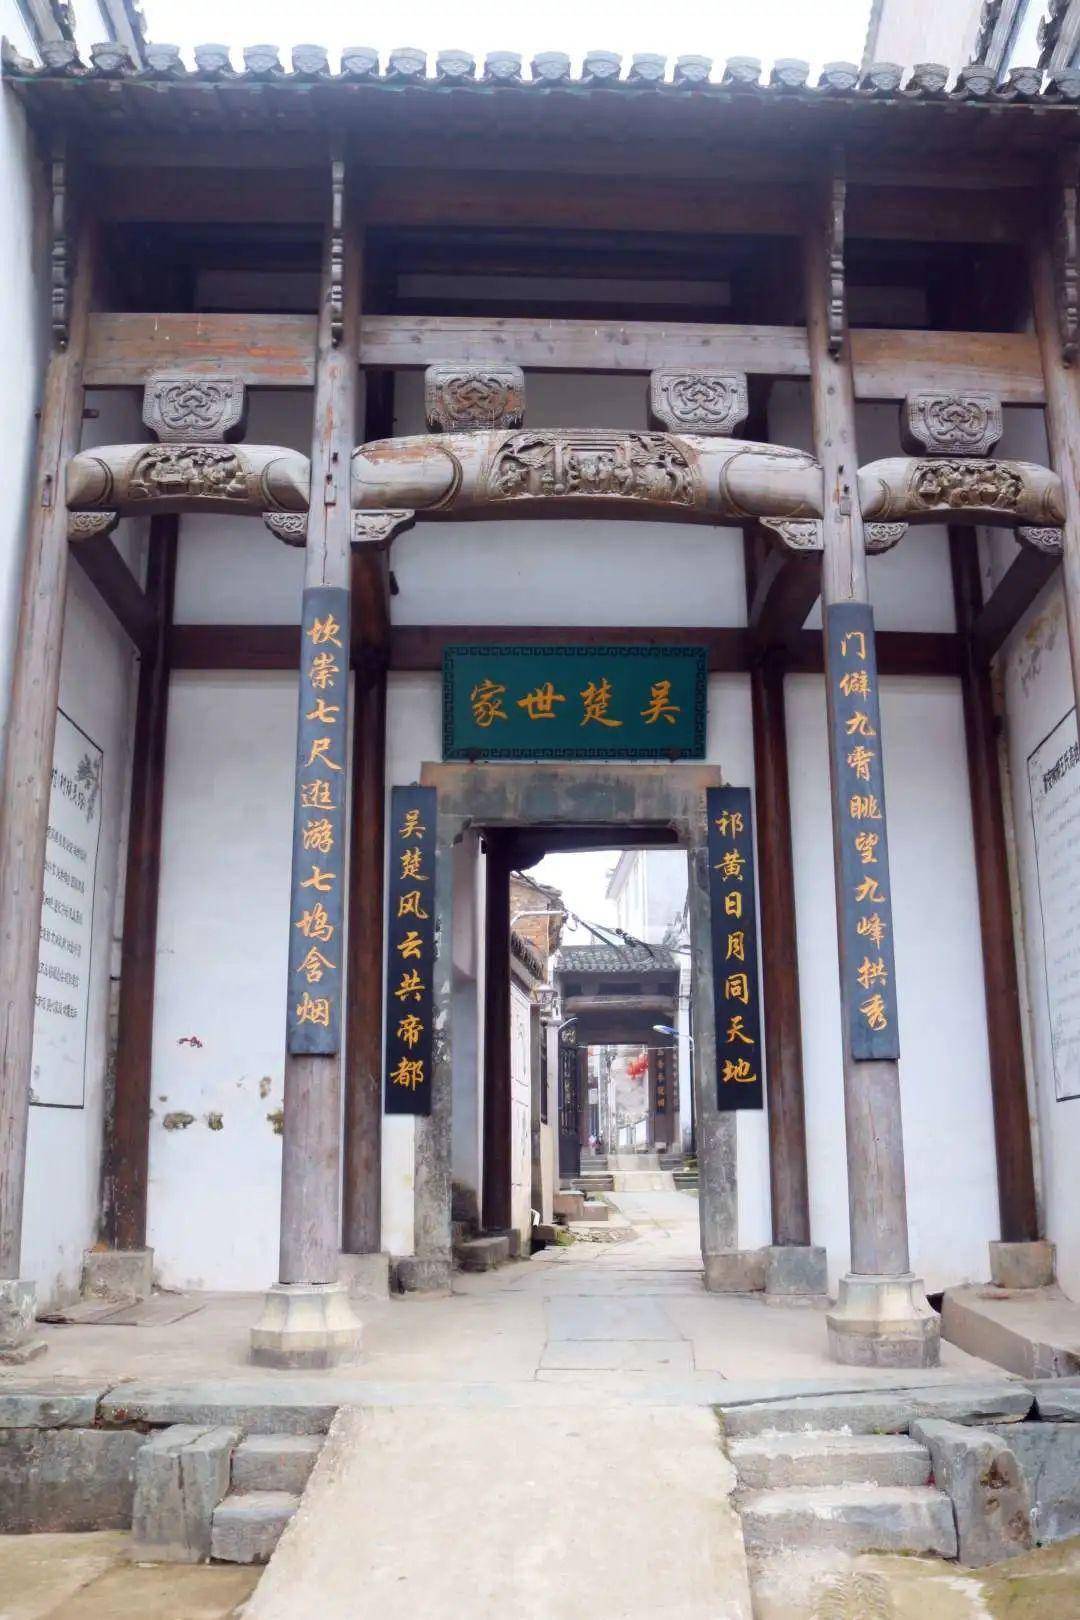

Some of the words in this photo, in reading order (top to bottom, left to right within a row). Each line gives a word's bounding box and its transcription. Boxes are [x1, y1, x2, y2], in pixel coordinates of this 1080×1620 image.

[470, 678, 681, 727] 吴楚世家
[390, 810, 429, 1089] 吴楚风云共帝都
[714, 811, 757, 1083] 祁黄日月同天地
